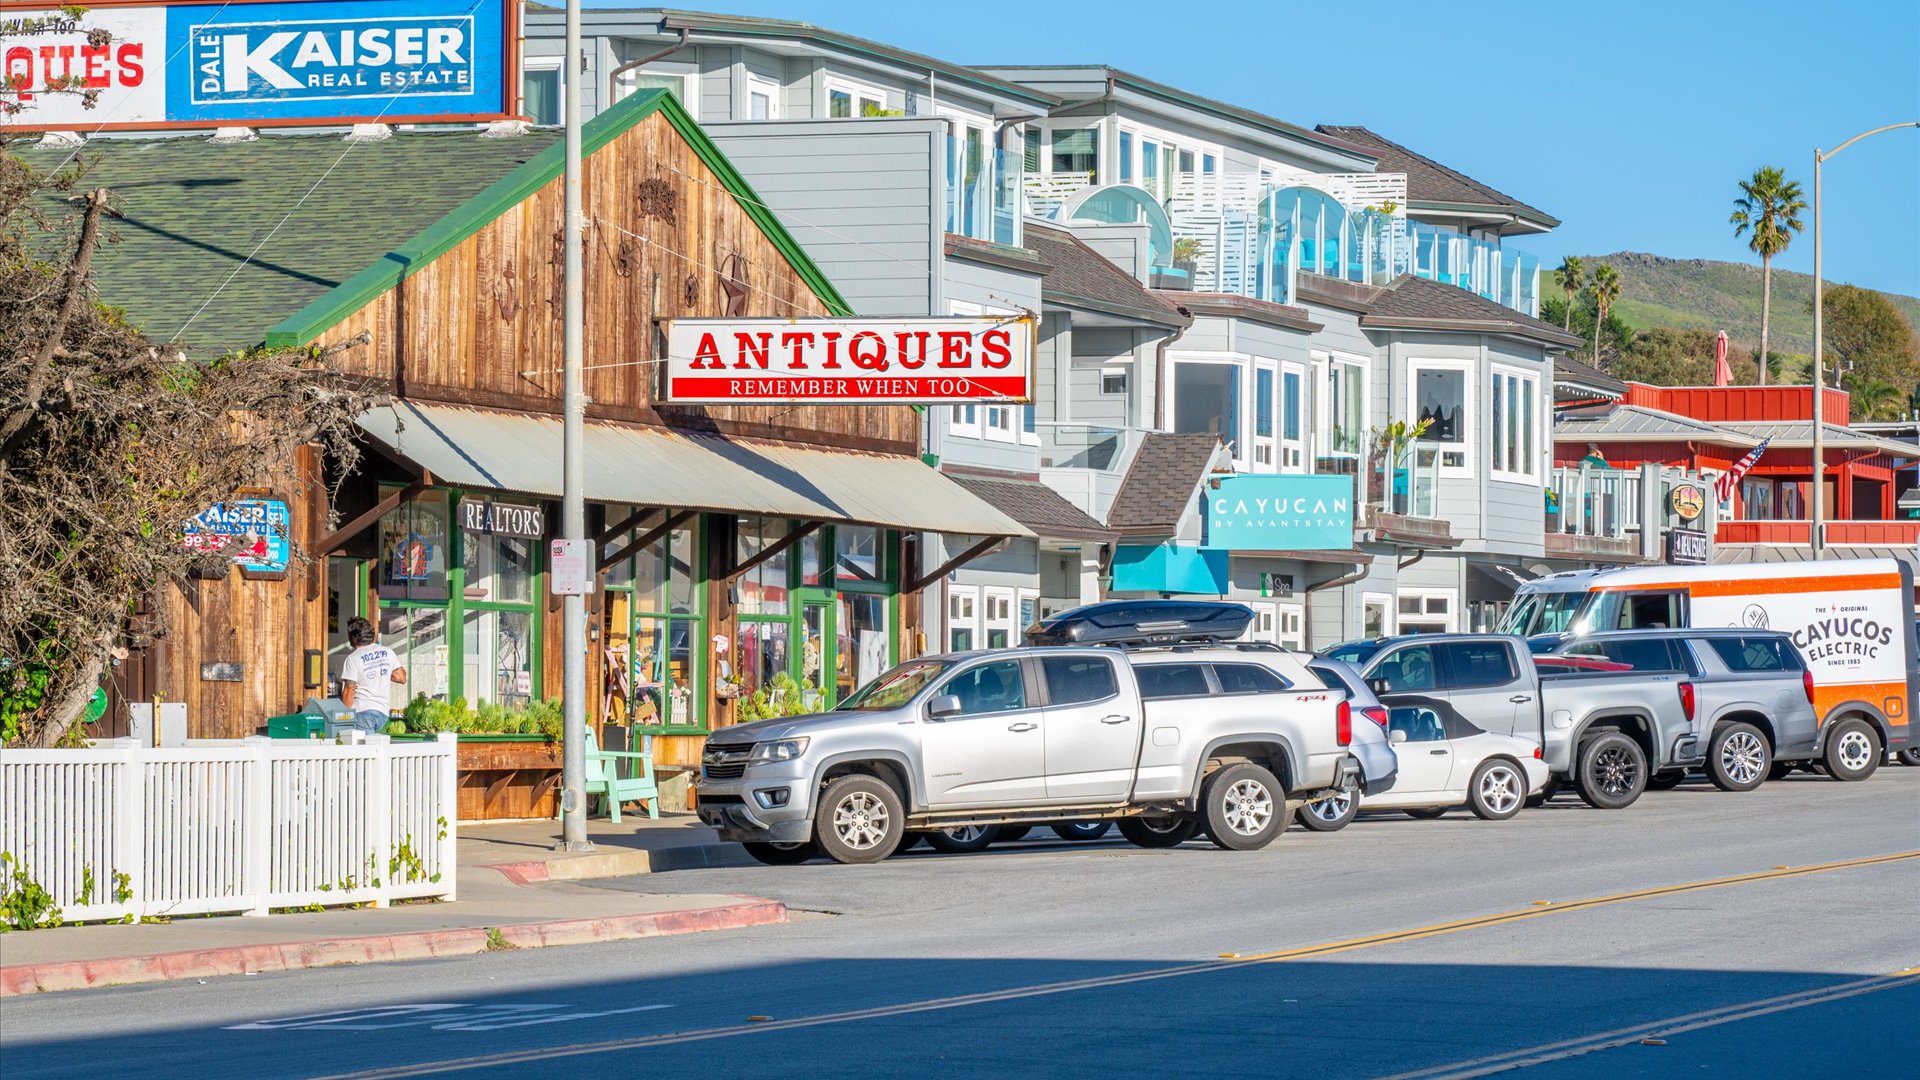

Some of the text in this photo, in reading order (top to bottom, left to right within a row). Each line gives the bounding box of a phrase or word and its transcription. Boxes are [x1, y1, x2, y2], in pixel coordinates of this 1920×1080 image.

[6, 43, 144, 101] QUES
[200, 33, 221, 93] DALE
[223, 28, 466, 92] KAISER
[308, 70, 468, 87] REAL ESTATE
[689, 330, 1013, 372] ANTIQUES
[730, 379, 970, 396] REMEMBER WHEN TOO
[1215, 498, 1347, 514] CAYUCAN
[466, 503, 540, 536] REALTORS
[1246, 519, 1345, 527] AVANTSTAY
[1274, 577, 1291, 594] Spa
[1792, 617, 1892, 649] CAYUCOS
[1808, 642, 1878, 662] ELECTRIC
